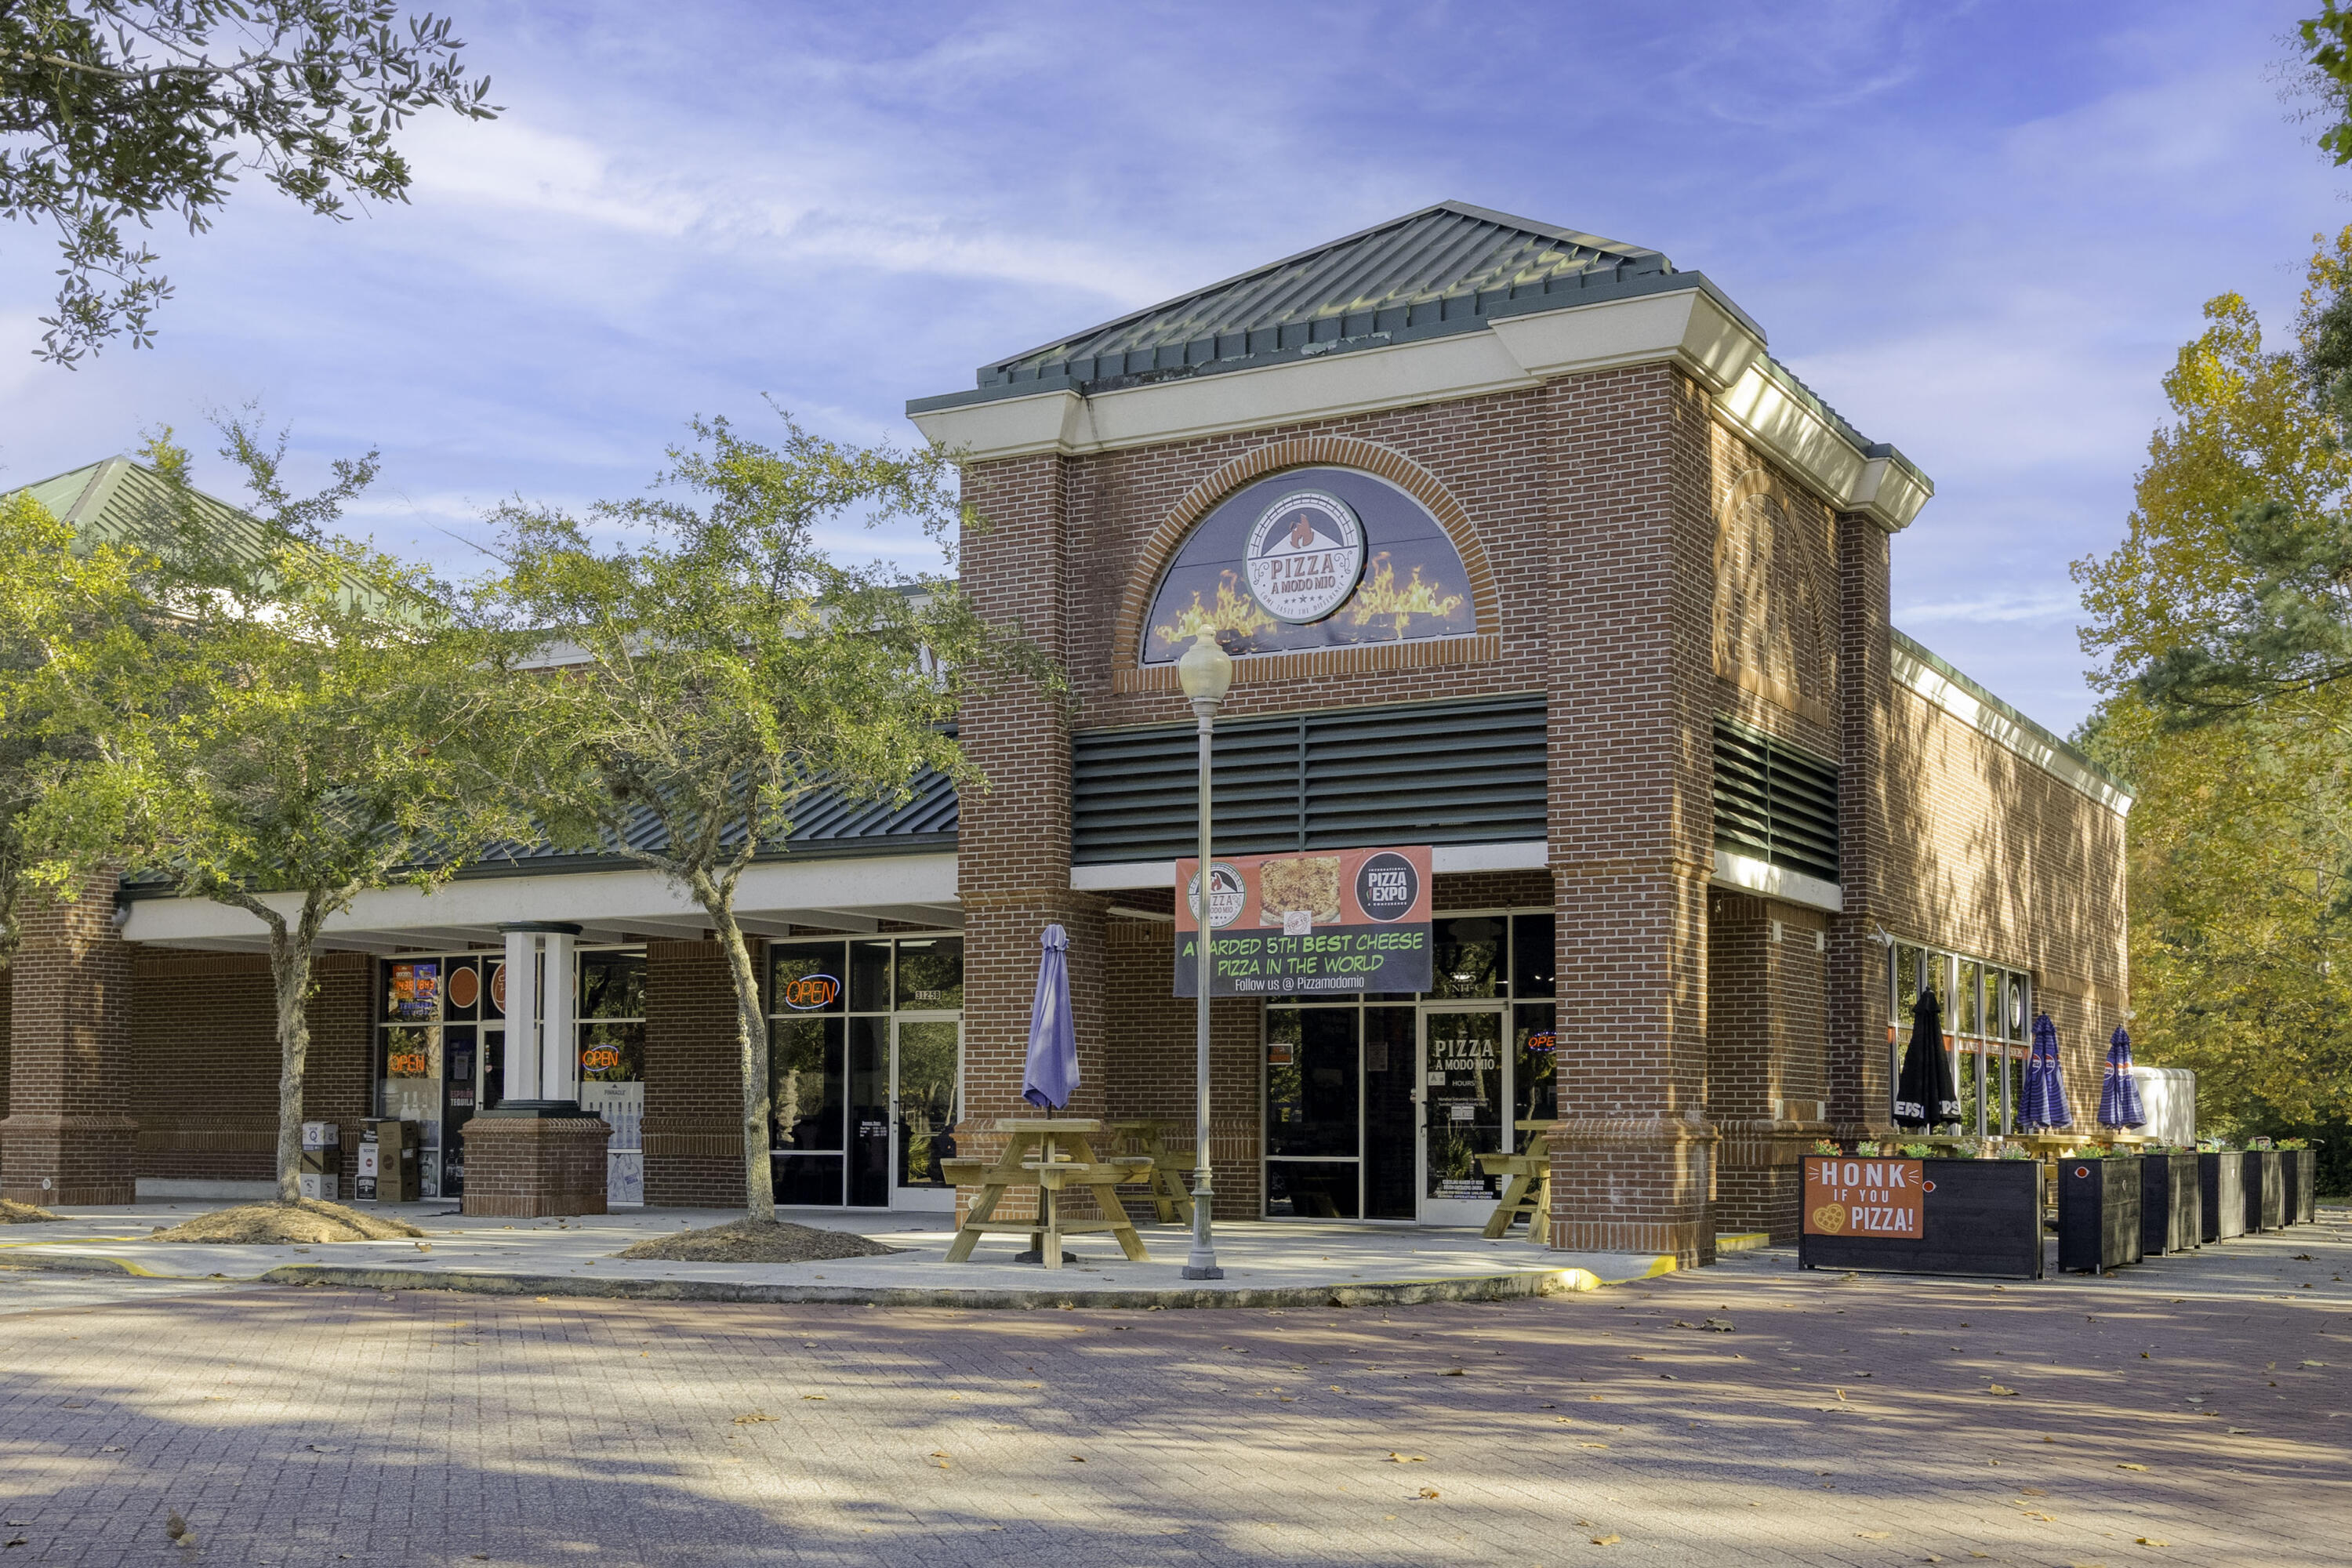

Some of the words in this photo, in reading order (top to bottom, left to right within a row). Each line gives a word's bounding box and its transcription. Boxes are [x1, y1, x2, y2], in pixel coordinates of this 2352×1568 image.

[1271, 554, 1334, 579] PIZZA
[1271, 582, 1279, 594] A
[1281, 579, 1313, 593] MODO
[1315, 575, 1336, 590] MIO
[1368, 871, 1407, 887] PIZZA
[1212, 895, 1232, 906] ZZA
[1372, 886, 1407, 902] EXPO
[1182, 938, 1261, 956] AARDED
[1267, 936, 1298, 954] 5TH
[1303, 935, 1352, 953] BEST
[1356, 932, 1424, 951] CHEESE
[1218, 959, 1260, 977] PIZZA
[1266, 958, 1282, 975] IN
[1287, 956, 1317, 974] THE
[1324, 954, 1385, 973] WORLD
[786, 980, 836, 1004] OPEN
[1236, 978, 1265, 991] Follow
[1268, 979, 1279, 990] us
[1283, 978, 1294, 991] @
[1298, 975, 1364, 989] Pizzamodomio
[1435, 1040, 1494, 1058] PIZZA
[1529, 1036, 1556, 1047] OPE
[390, 1054, 425, 1072] OPEN
[583, 1050, 619, 1066] OPEN
[1436, 1059, 1443, 1070] A
[1445, 1059, 1474, 1070] MODO
[1475, 1058, 1495, 1070] MIO
[1893, 1101, 1924, 1119] EPSI
[1821, 1161, 1906, 1188] HONK
[1834, 1189, 1848, 1201] IF
[1859, 1189, 1889, 1203] YOU
[1852, 1207, 1914, 1232] PIZZA!
